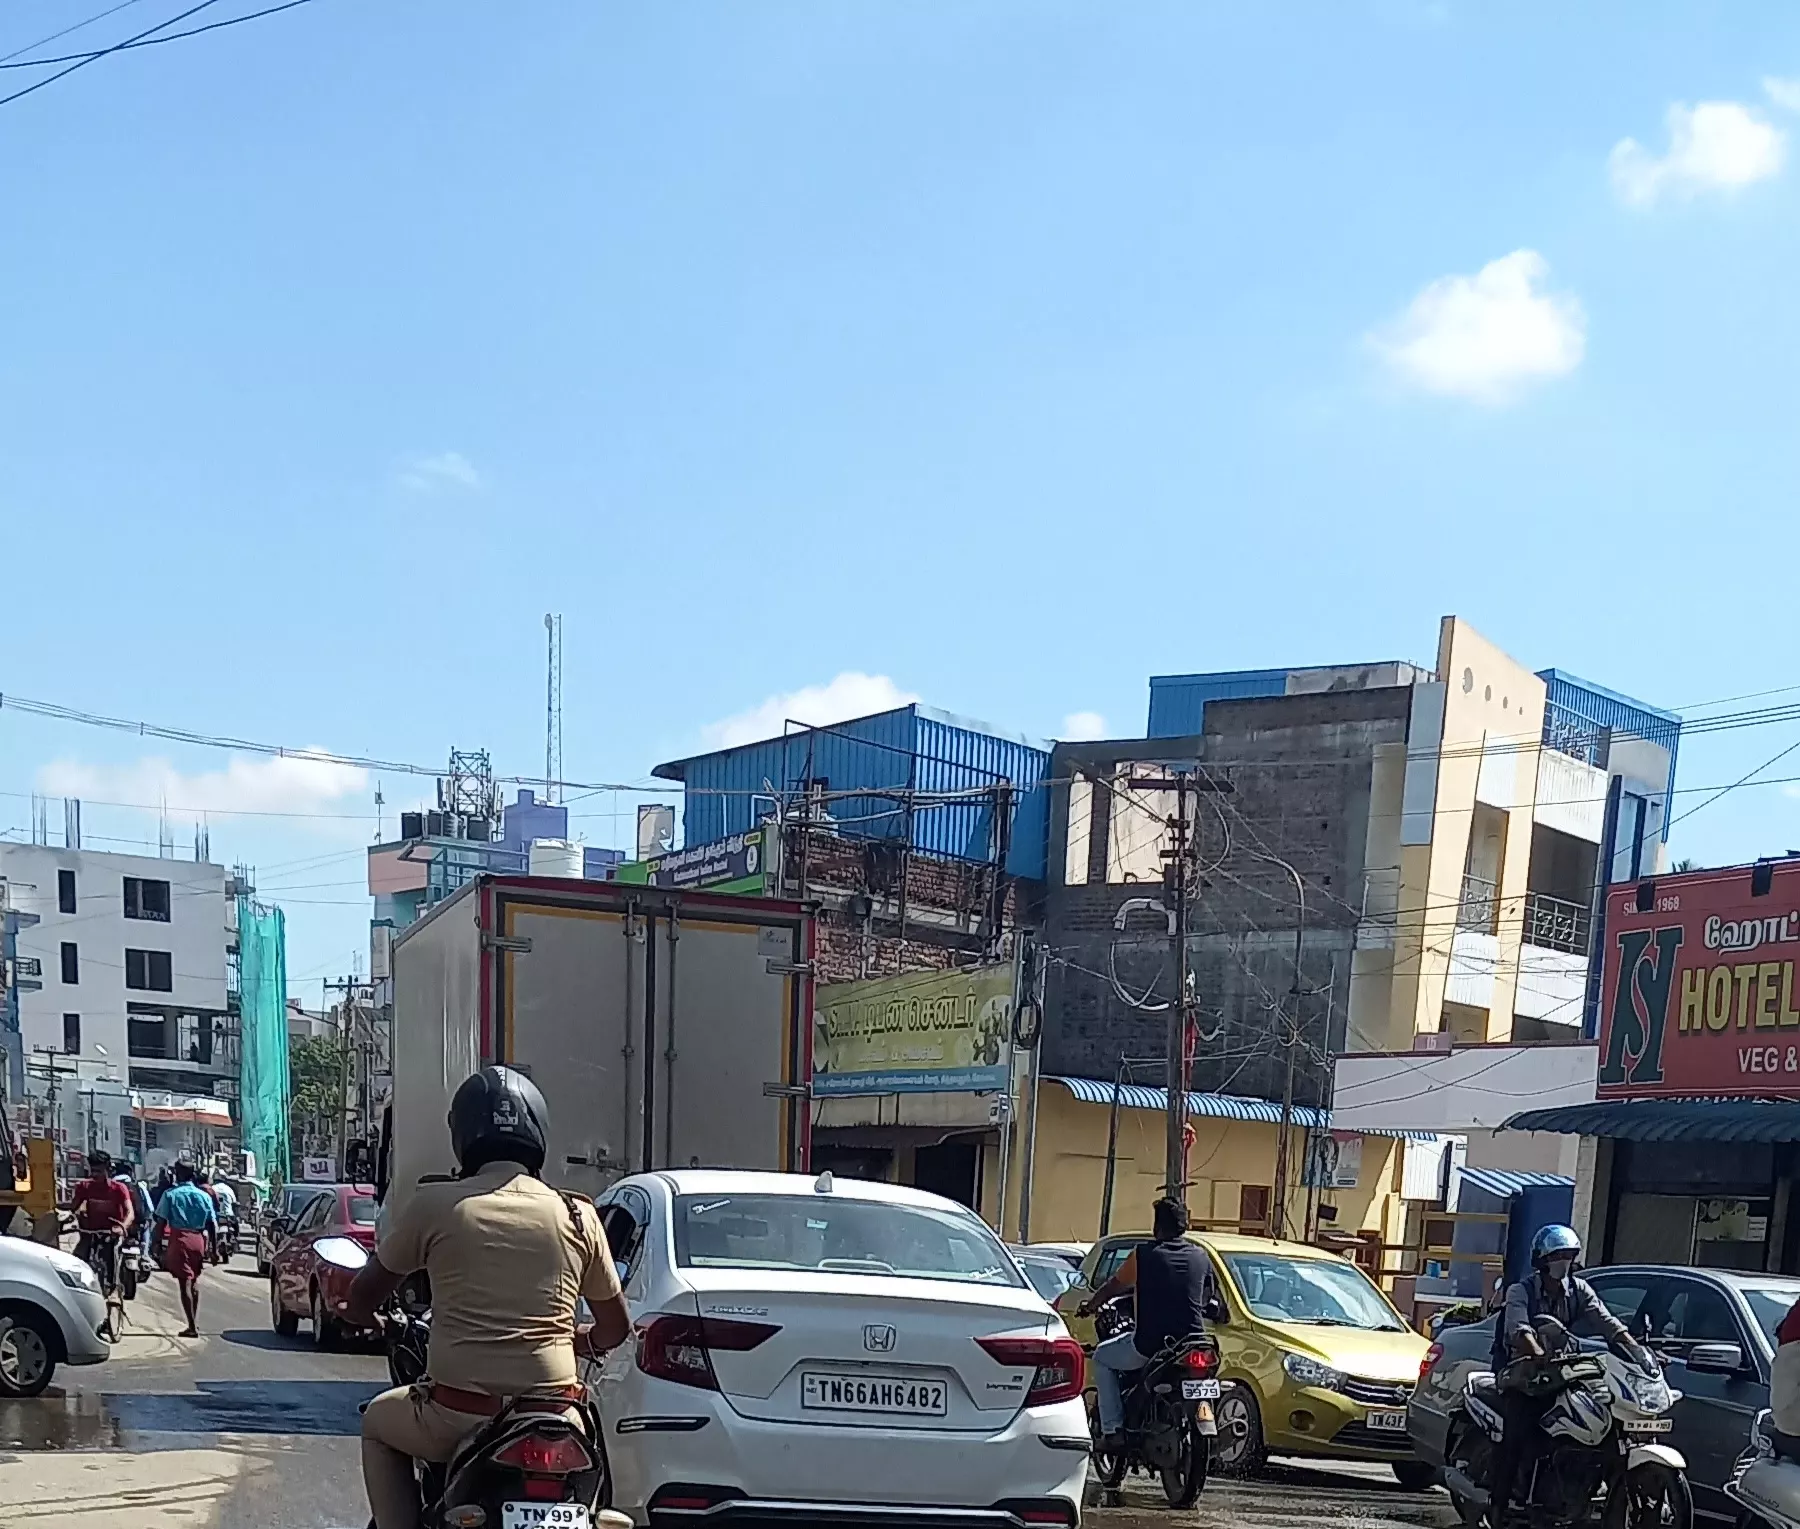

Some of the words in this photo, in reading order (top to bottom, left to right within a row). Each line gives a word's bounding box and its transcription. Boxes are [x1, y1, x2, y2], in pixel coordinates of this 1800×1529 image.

[1657, 896, 1680, 912] 1968
[1679, 962, 1800, 1031] HOTEL
[1738, 1048, 1779, 1073] VEG
[1785, 1046, 1798, 1072] &
[818, 1380, 942, 1409] TN66AH6482
[1185, 1388, 1218, 1398] 3979
[520, 1508, 546, 1522] TN
[551, 1510, 573, 1523] 99
